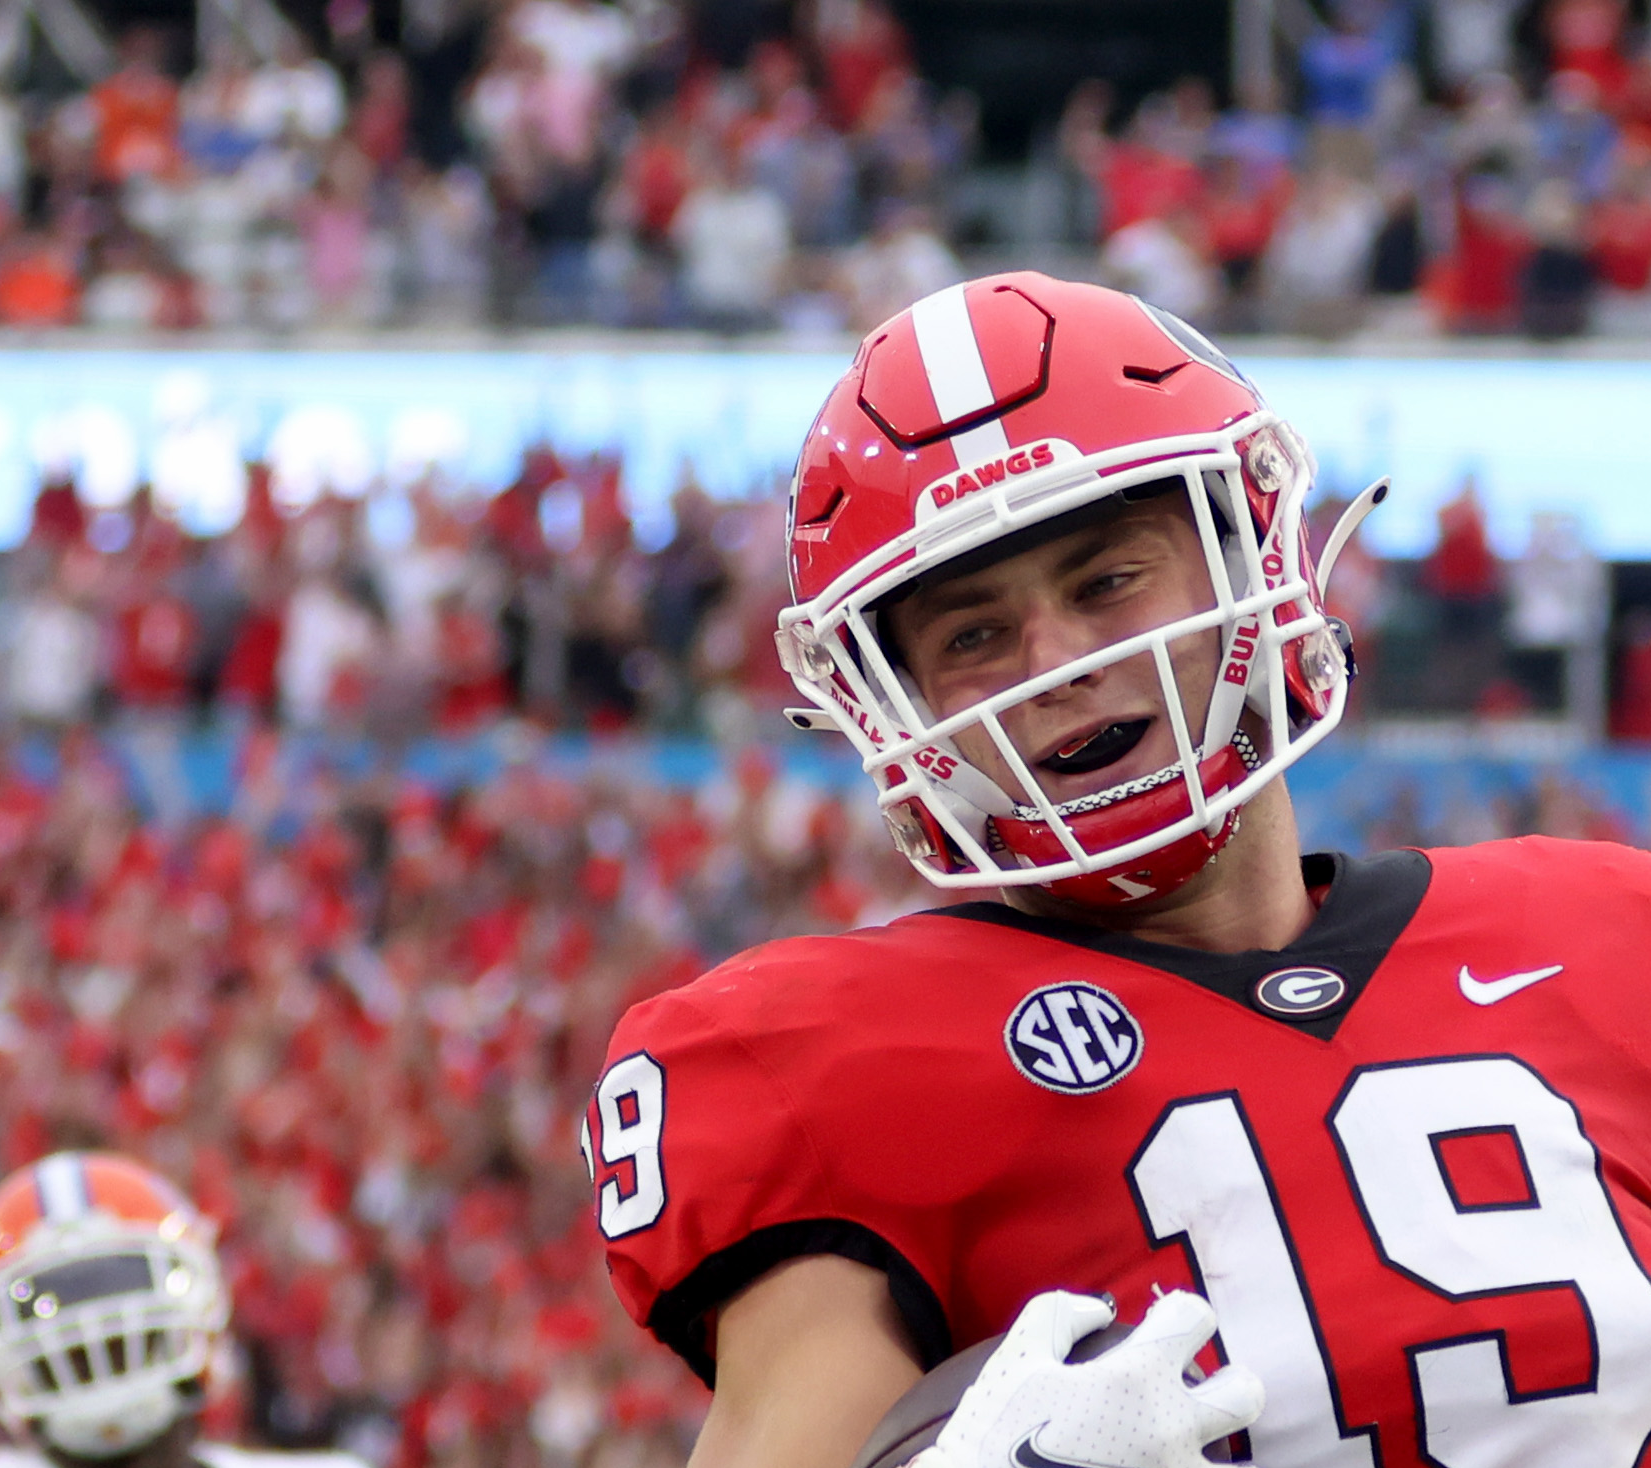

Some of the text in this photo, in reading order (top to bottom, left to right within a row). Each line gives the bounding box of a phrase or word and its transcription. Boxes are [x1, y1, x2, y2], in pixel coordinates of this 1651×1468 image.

[930, 443, 1054, 509] DAWGS
[1259, 967, 1345, 1011] G
[1016, 989, 1134, 1086] SEC
